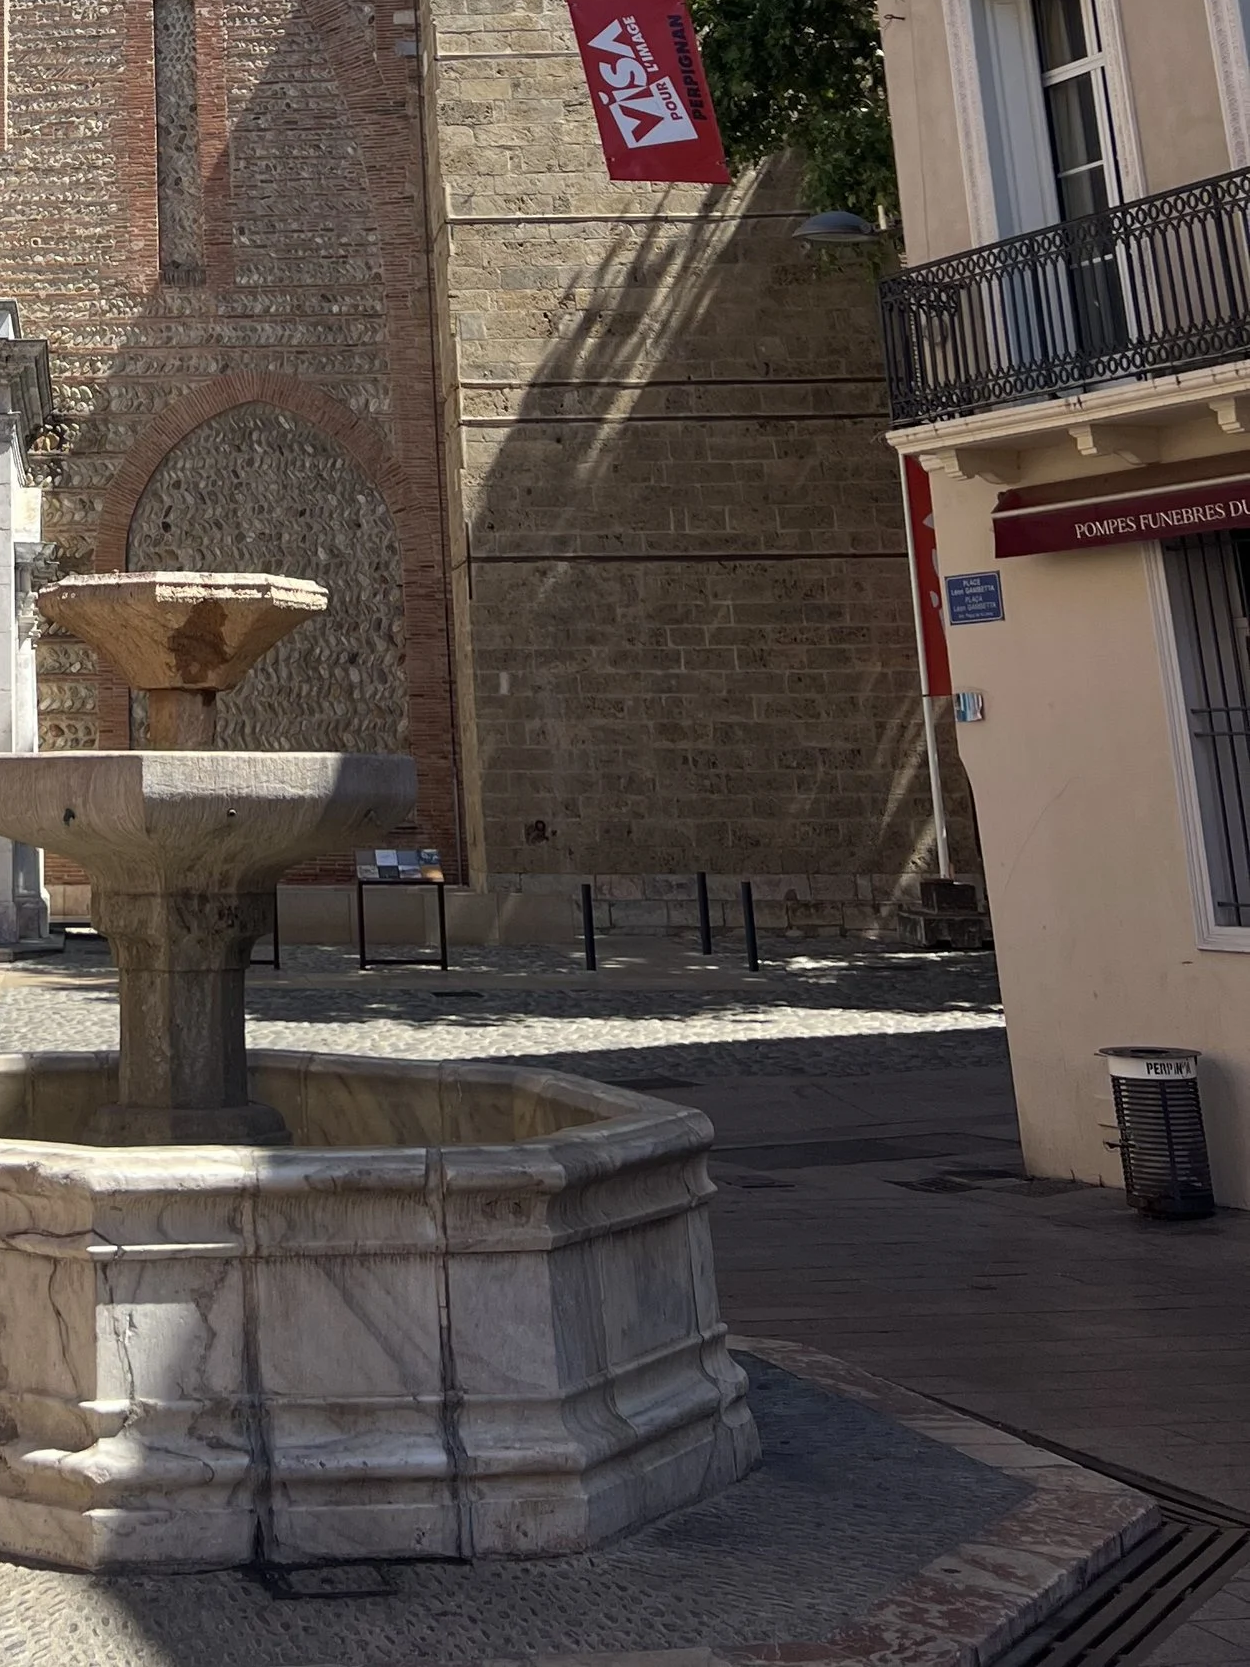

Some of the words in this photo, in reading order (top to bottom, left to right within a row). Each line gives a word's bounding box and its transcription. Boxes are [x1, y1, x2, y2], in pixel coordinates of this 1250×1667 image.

[622, 15, 659, 73] L'IMAGE
[667, 14, 707, 122] PERPIGNAN
[656, 82, 683, 121] POUR
[1074, 516, 1137, 539] POMPES
[1139, 503, 1226, 531] FUNEBRES
